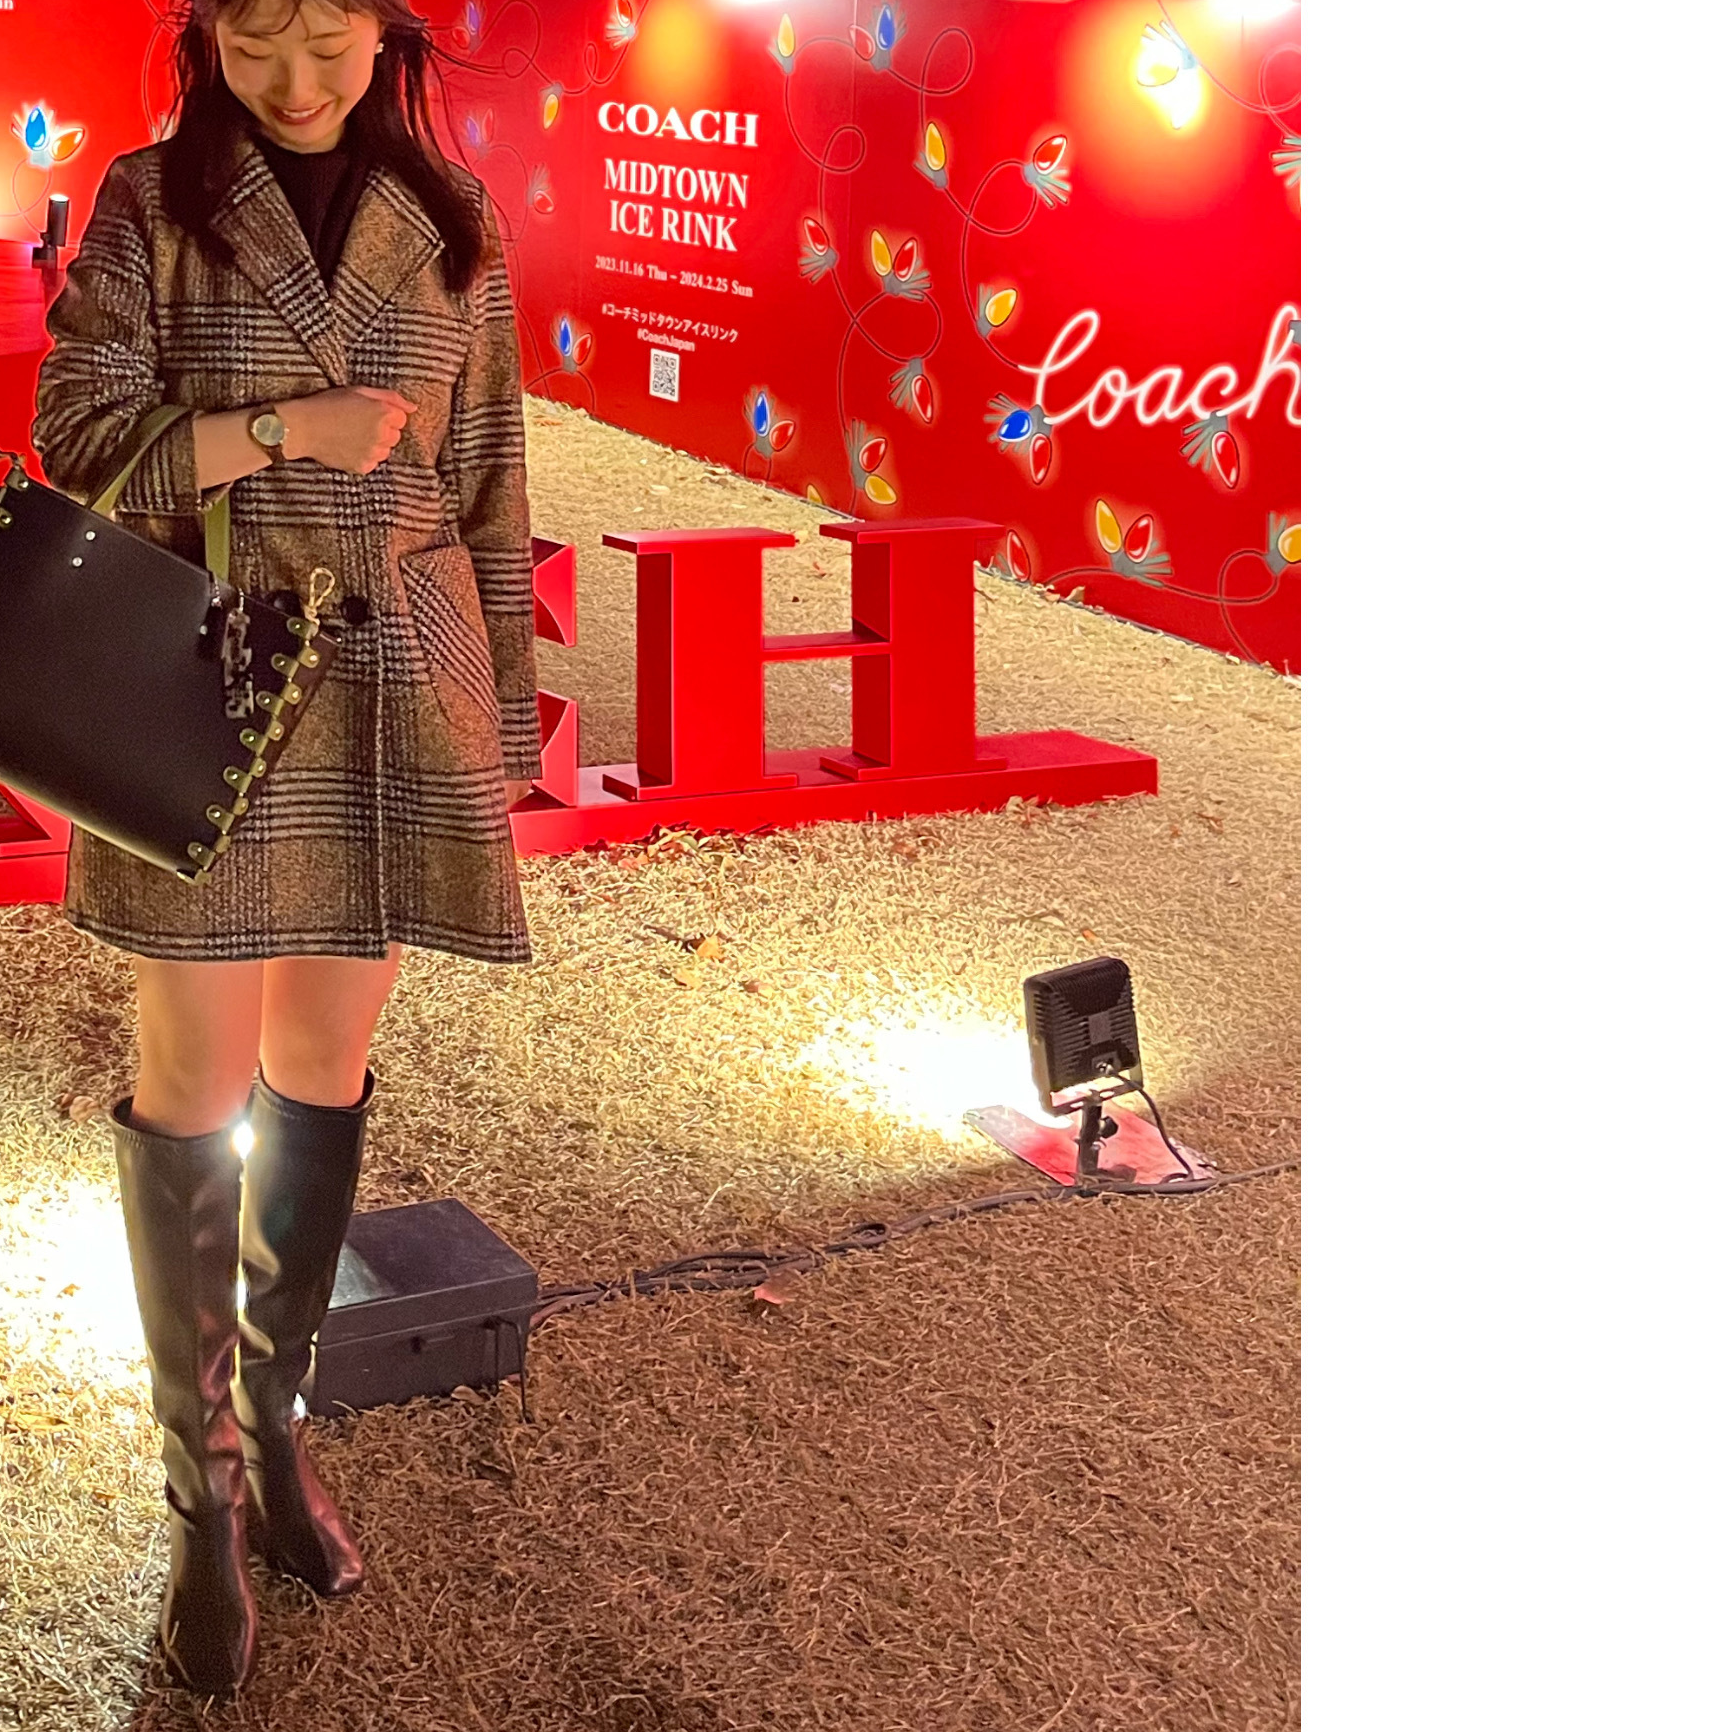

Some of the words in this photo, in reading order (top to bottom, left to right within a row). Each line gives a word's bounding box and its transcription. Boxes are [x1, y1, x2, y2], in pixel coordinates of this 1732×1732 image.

[598, 101, 758, 147] COACH
[604, 158, 748, 209] MIDTOWN
[609, 199, 654, 238] ICE
[661, 206, 738, 252] RINK
[595, 255, 644, 277] 2023.11.16
[646, 263, 668, 282] Thu
[679, 270, 728, 293] 2024.2.25
[731, 279, 754, 298] Sun
[636, 327, 696, 352] #CoachJapan
